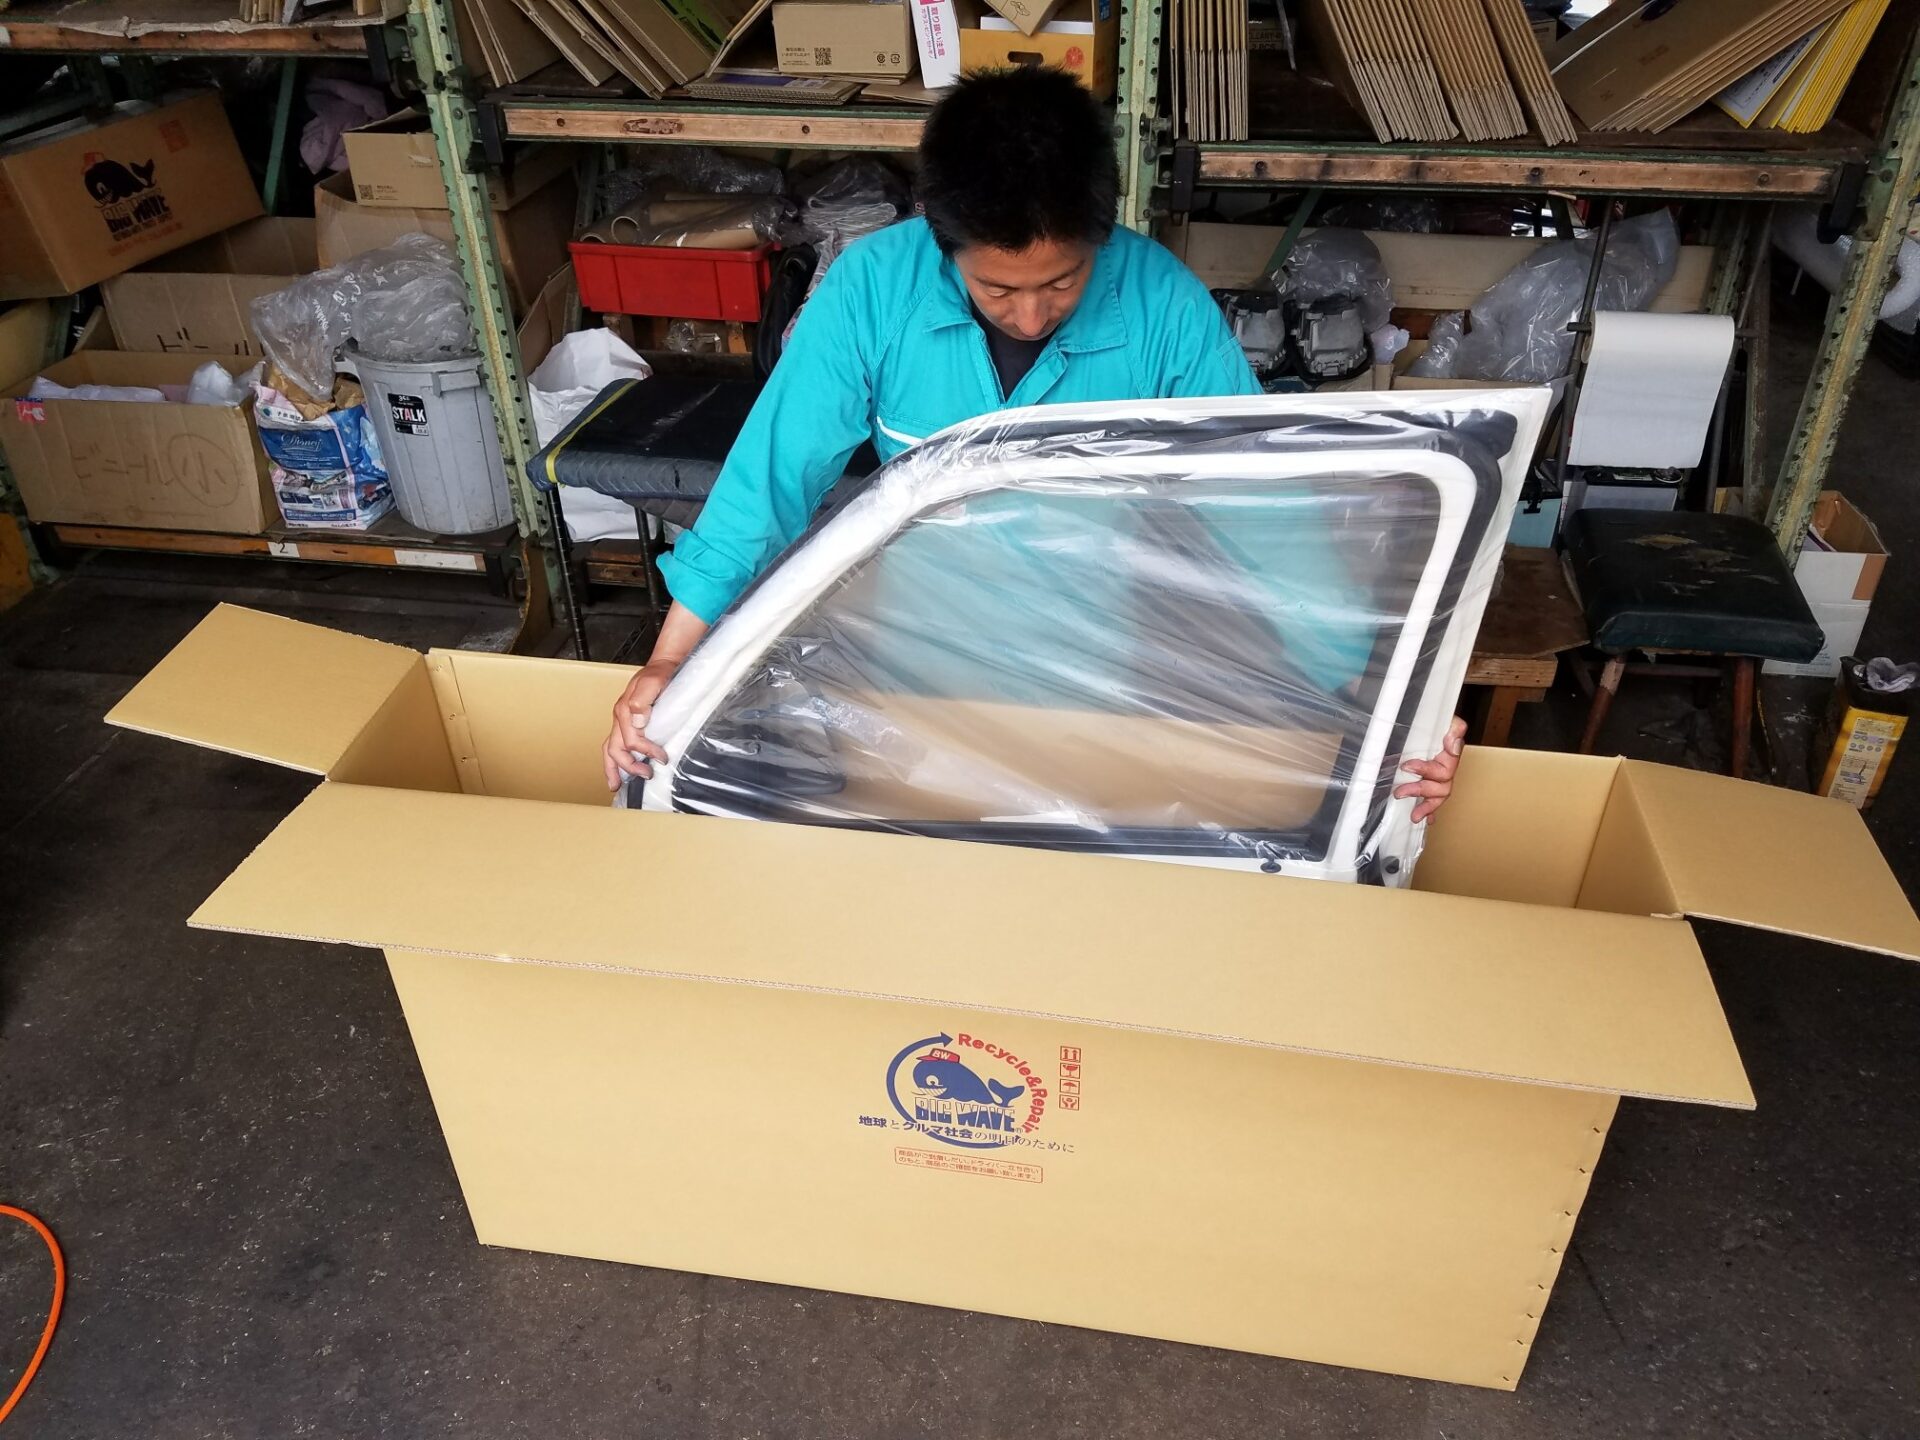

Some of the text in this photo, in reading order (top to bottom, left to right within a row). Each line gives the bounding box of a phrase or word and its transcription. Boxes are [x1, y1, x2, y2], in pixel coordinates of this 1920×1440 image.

[392, 406, 426, 422] STALK
[281, 433, 323, 452] Disney
[932, 1050, 950, 1060] BW
[915, 1097, 1015, 1132] BIG WAVE
